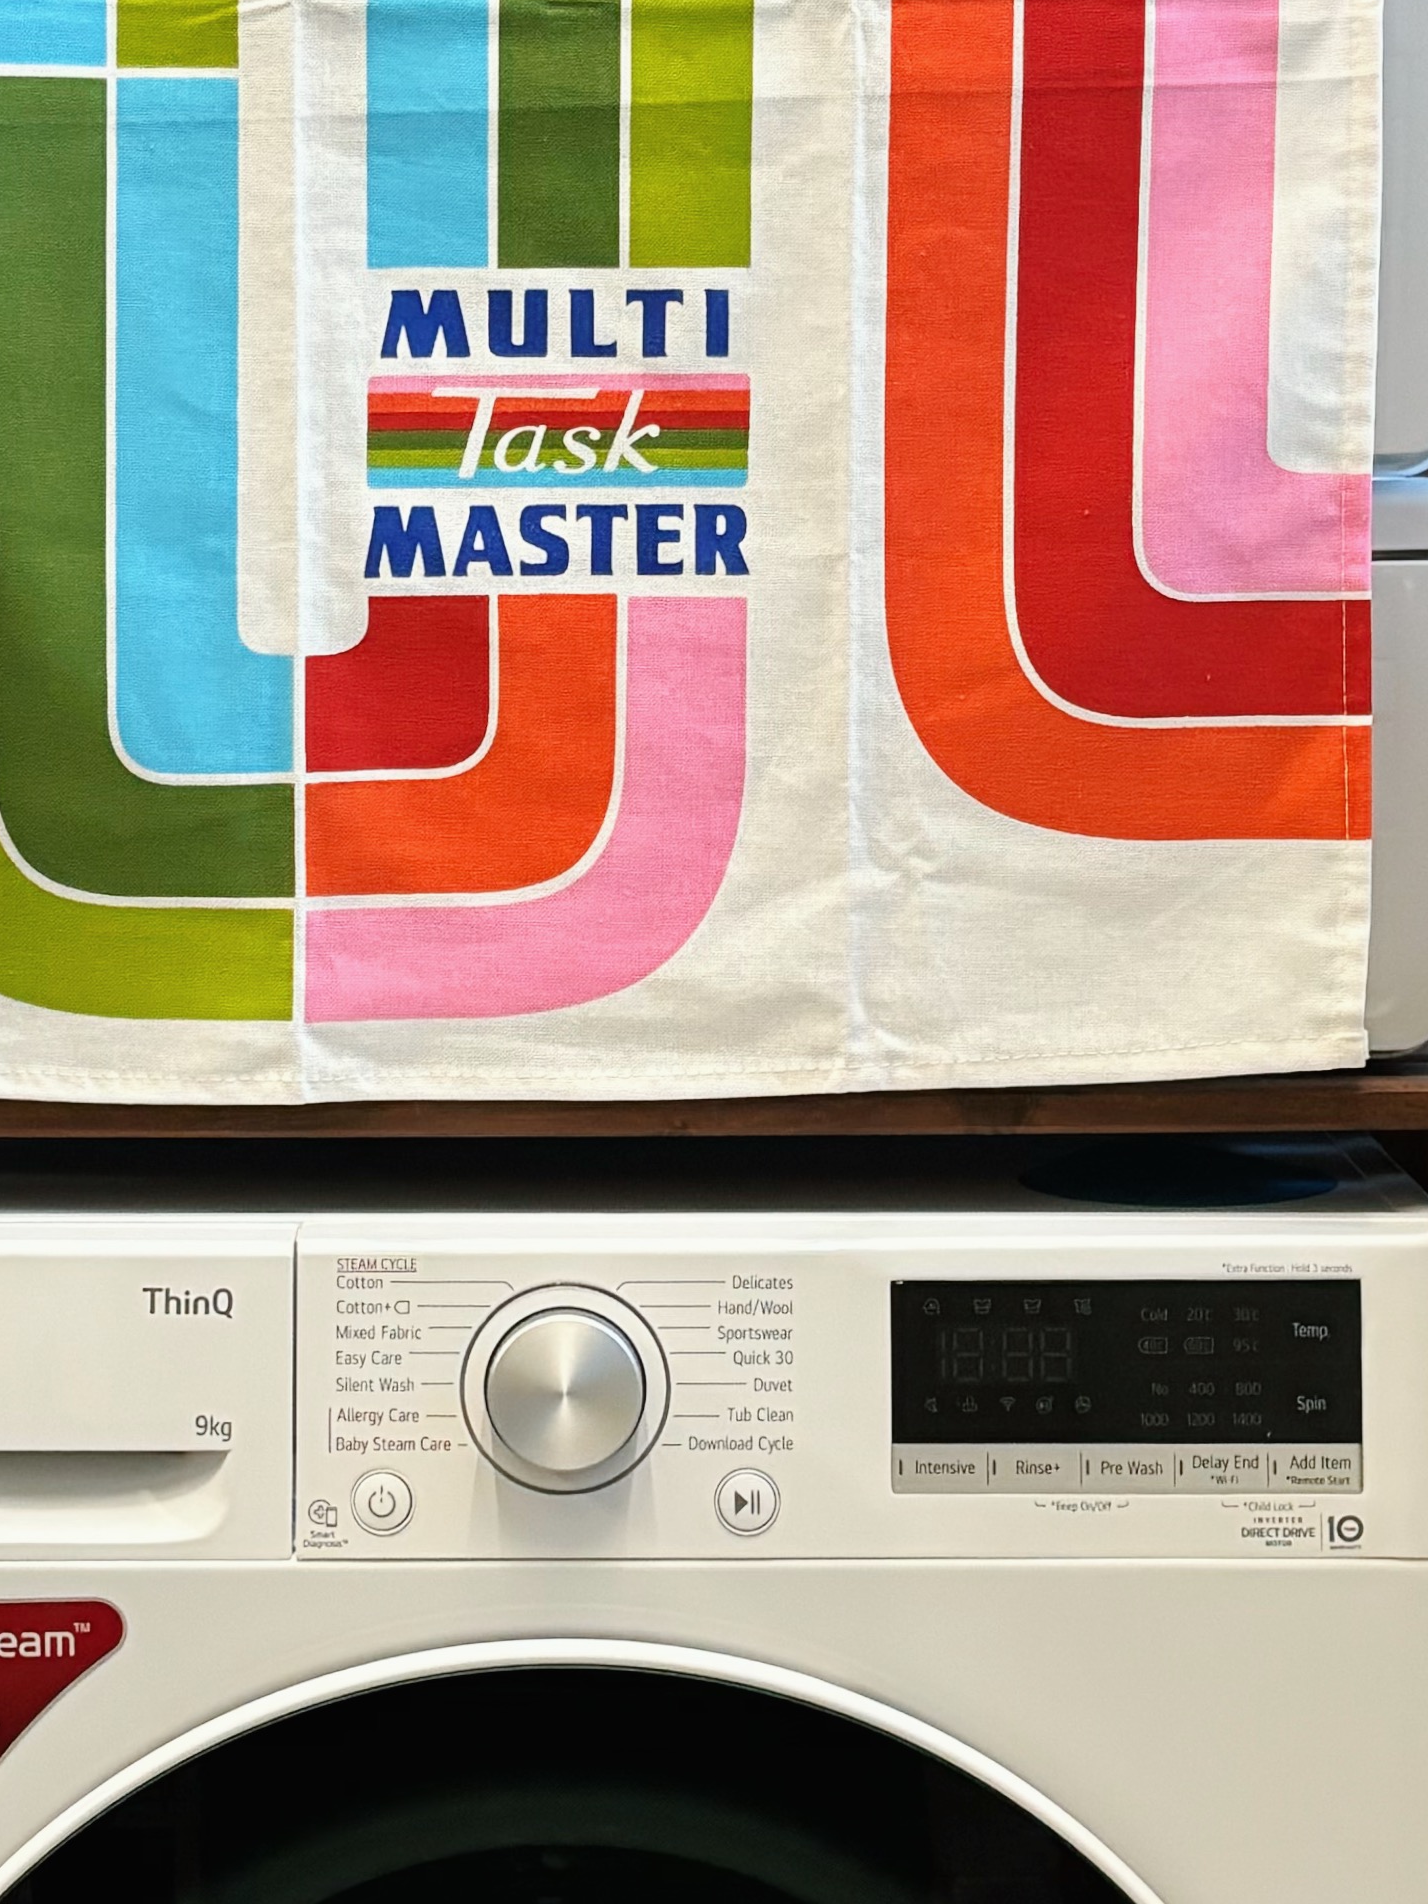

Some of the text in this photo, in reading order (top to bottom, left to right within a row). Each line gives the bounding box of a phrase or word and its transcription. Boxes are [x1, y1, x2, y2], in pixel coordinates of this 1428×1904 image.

[380, 288, 730, 359] MULTI
[431, 386, 661, 480] Task
[364, 503, 751, 578] MASTER
[336, 1257, 417, 1271] STEAM CYCLE
[336, 1274, 384, 1290] Cotton
[732, 1274, 794, 1290] Delicates
[142, 1286, 234, 1319] ThinQ
[718, 1298, 794, 1317] Hand/Wool
[1140, 1307, 1169, 1322] Cold
[335, 1324, 422, 1341] Mixed Fabric
[717, 1324, 794, 1344] Sportswear
[335, 1350, 403, 1369] Easy Care
[732, 1349, 794, 1367] Quick 30
[335, 1376, 415, 1393] Silent Wash
[753, 1377, 794, 1393] Duvet
[1296, 1395, 1328, 1415] Spin
[336, 1407, 420, 1426] Allergy Care
[727, 1406, 794, 1423] Tub Clean
[194, 1414, 233, 1441] 9kg
[335, 1436, 452, 1455] Baby Steam Care
[688, 1435, 794, 1455] Download Cycle
[914, 1459, 976, 1476] Intensive
[1015, 1459, 1061, 1476] Rinse+
[1100, 1459, 1164, 1476] Pre Wash
[1192, 1454, 1260, 1472] Delay End
[1289, 1454, 1352, 1471] Add Item
[1273, 1501, 1294, 1512] Lock
[1240, 1526, 1317, 1539] DIRECT DRIVE
[1327, 1514, 1364, 1543] 10
